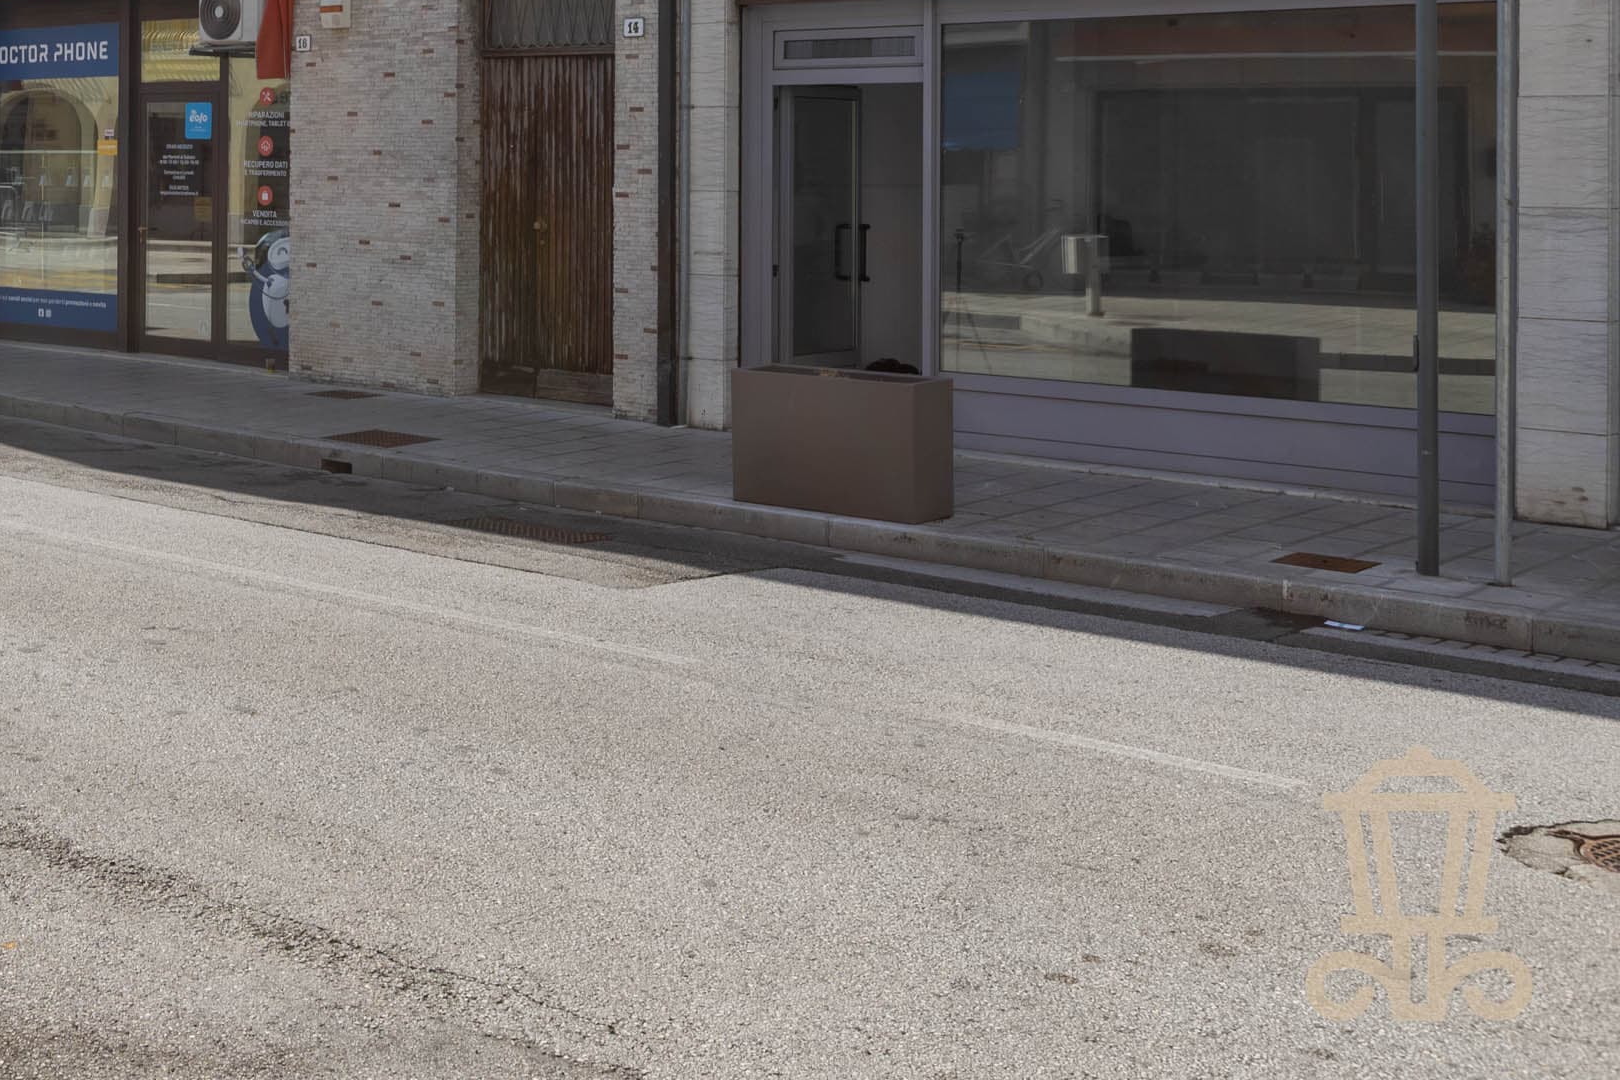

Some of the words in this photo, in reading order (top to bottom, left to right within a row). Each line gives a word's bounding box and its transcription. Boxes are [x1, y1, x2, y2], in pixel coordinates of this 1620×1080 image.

[627, 21, 640, 34] 14
[53, 40, 109, 62] PHONE
[243, 160, 275, 169] RECUPERO
[252, 209, 278, 218] VENDITA
